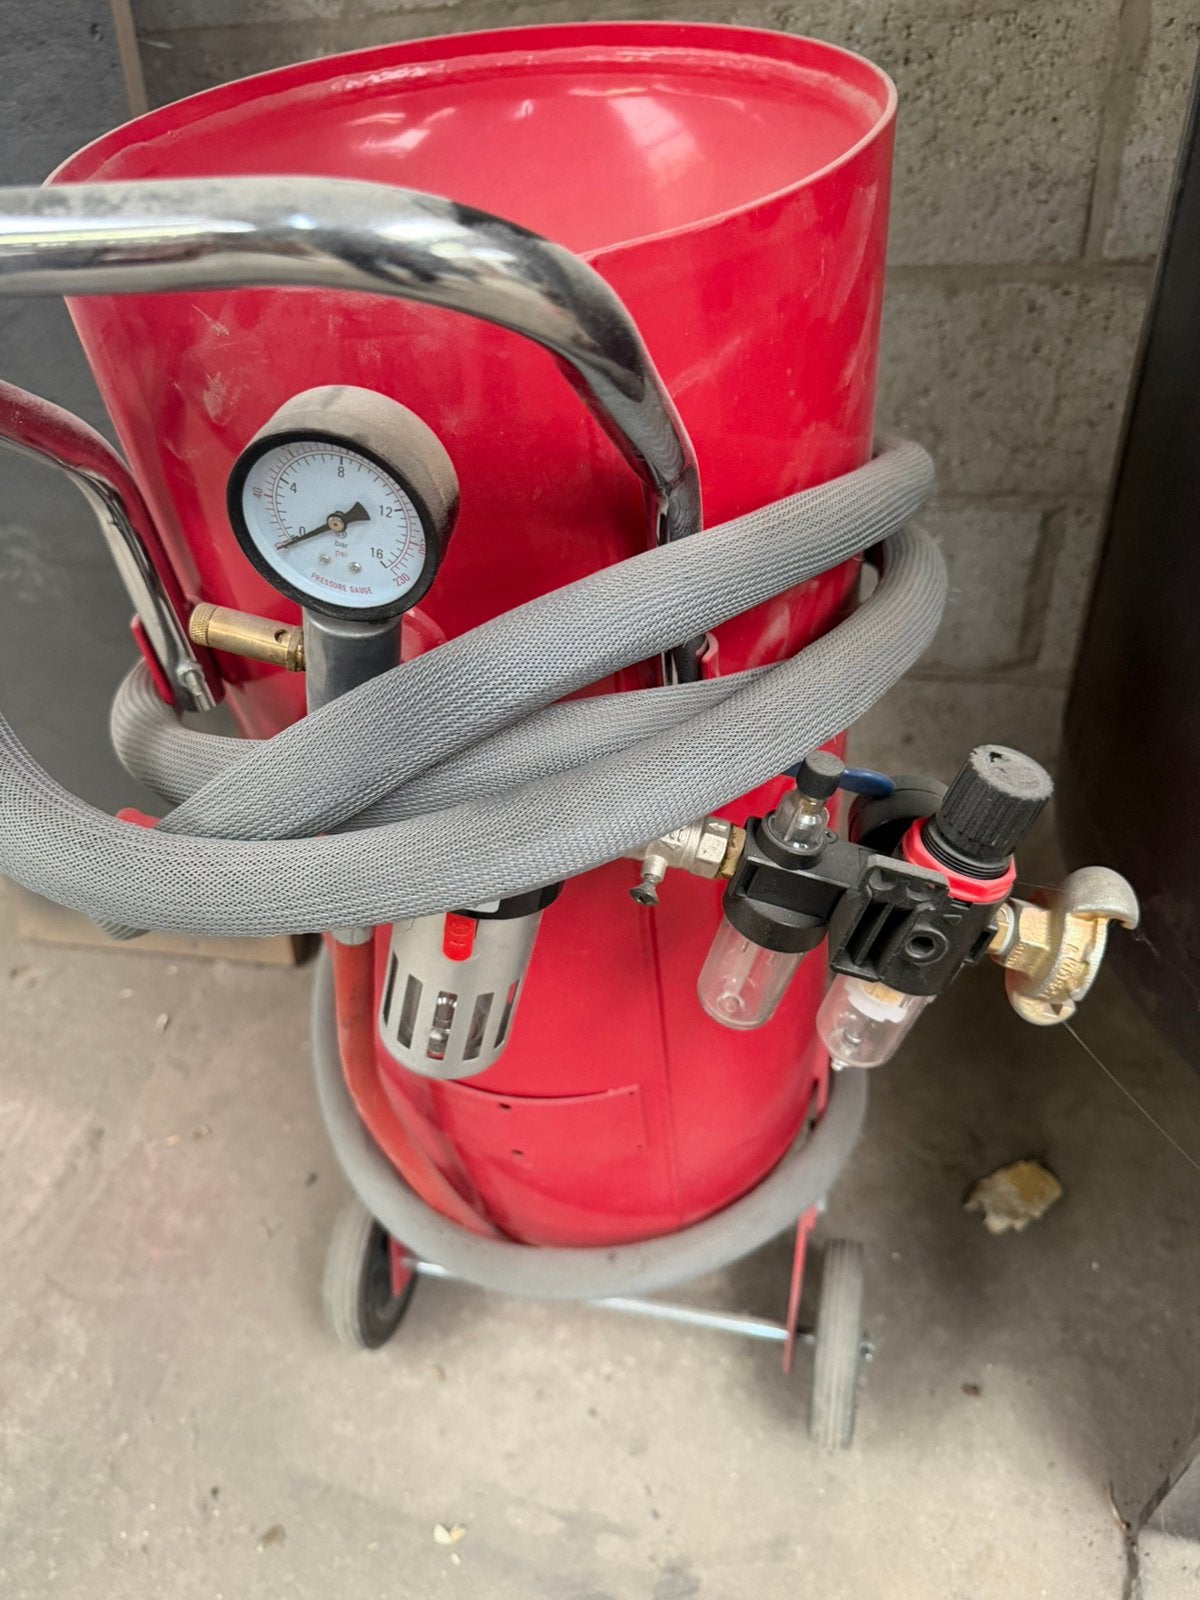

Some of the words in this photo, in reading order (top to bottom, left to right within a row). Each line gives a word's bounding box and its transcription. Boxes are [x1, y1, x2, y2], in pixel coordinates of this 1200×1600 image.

[338, 466, 345, 478] 8
[289, 483, 297, 494] 4
[379, 505, 393, 518] 12
[334, 540, 348, 548] bar
[370, 547, 384, 560] 16
[311, 572, 347, 592] PRESSURE
[350, 586, 373, 594] GAUGE
[392, 574, 410, 588] 230
